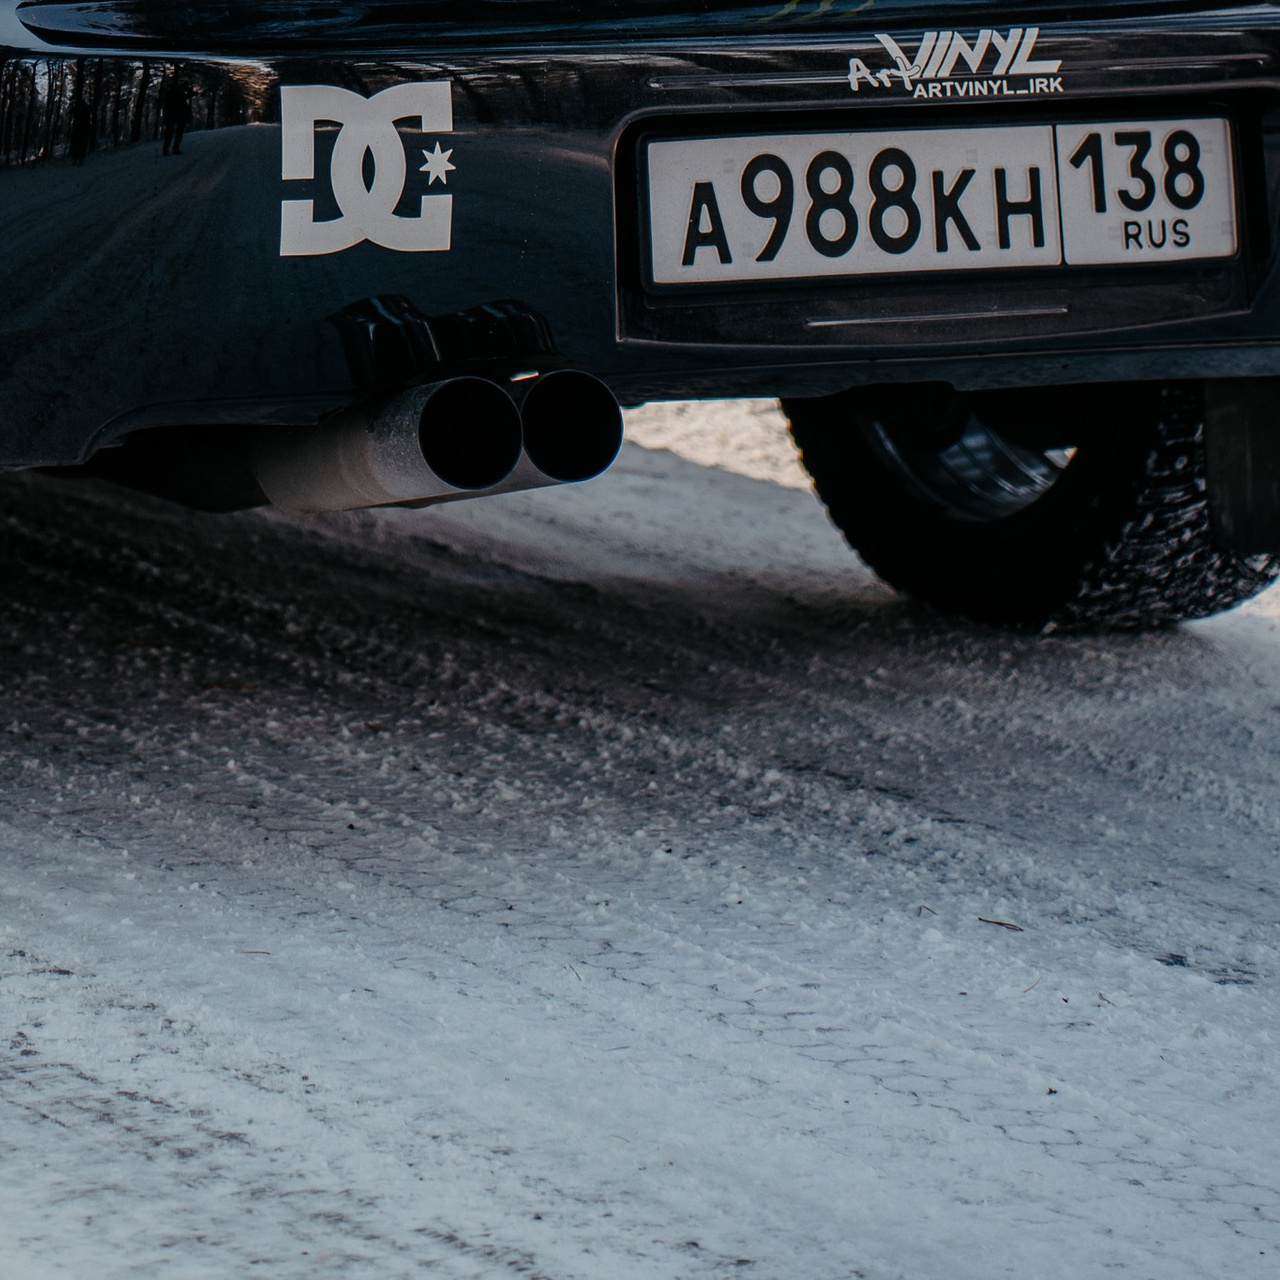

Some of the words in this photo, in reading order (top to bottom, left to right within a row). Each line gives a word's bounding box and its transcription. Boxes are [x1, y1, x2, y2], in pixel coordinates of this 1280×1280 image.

[913, 77, 1064, 99] ARTVINYL_IRK
[1068, 130, 1205, 214] 138
[1123, 219, 1190, 250] RUS
